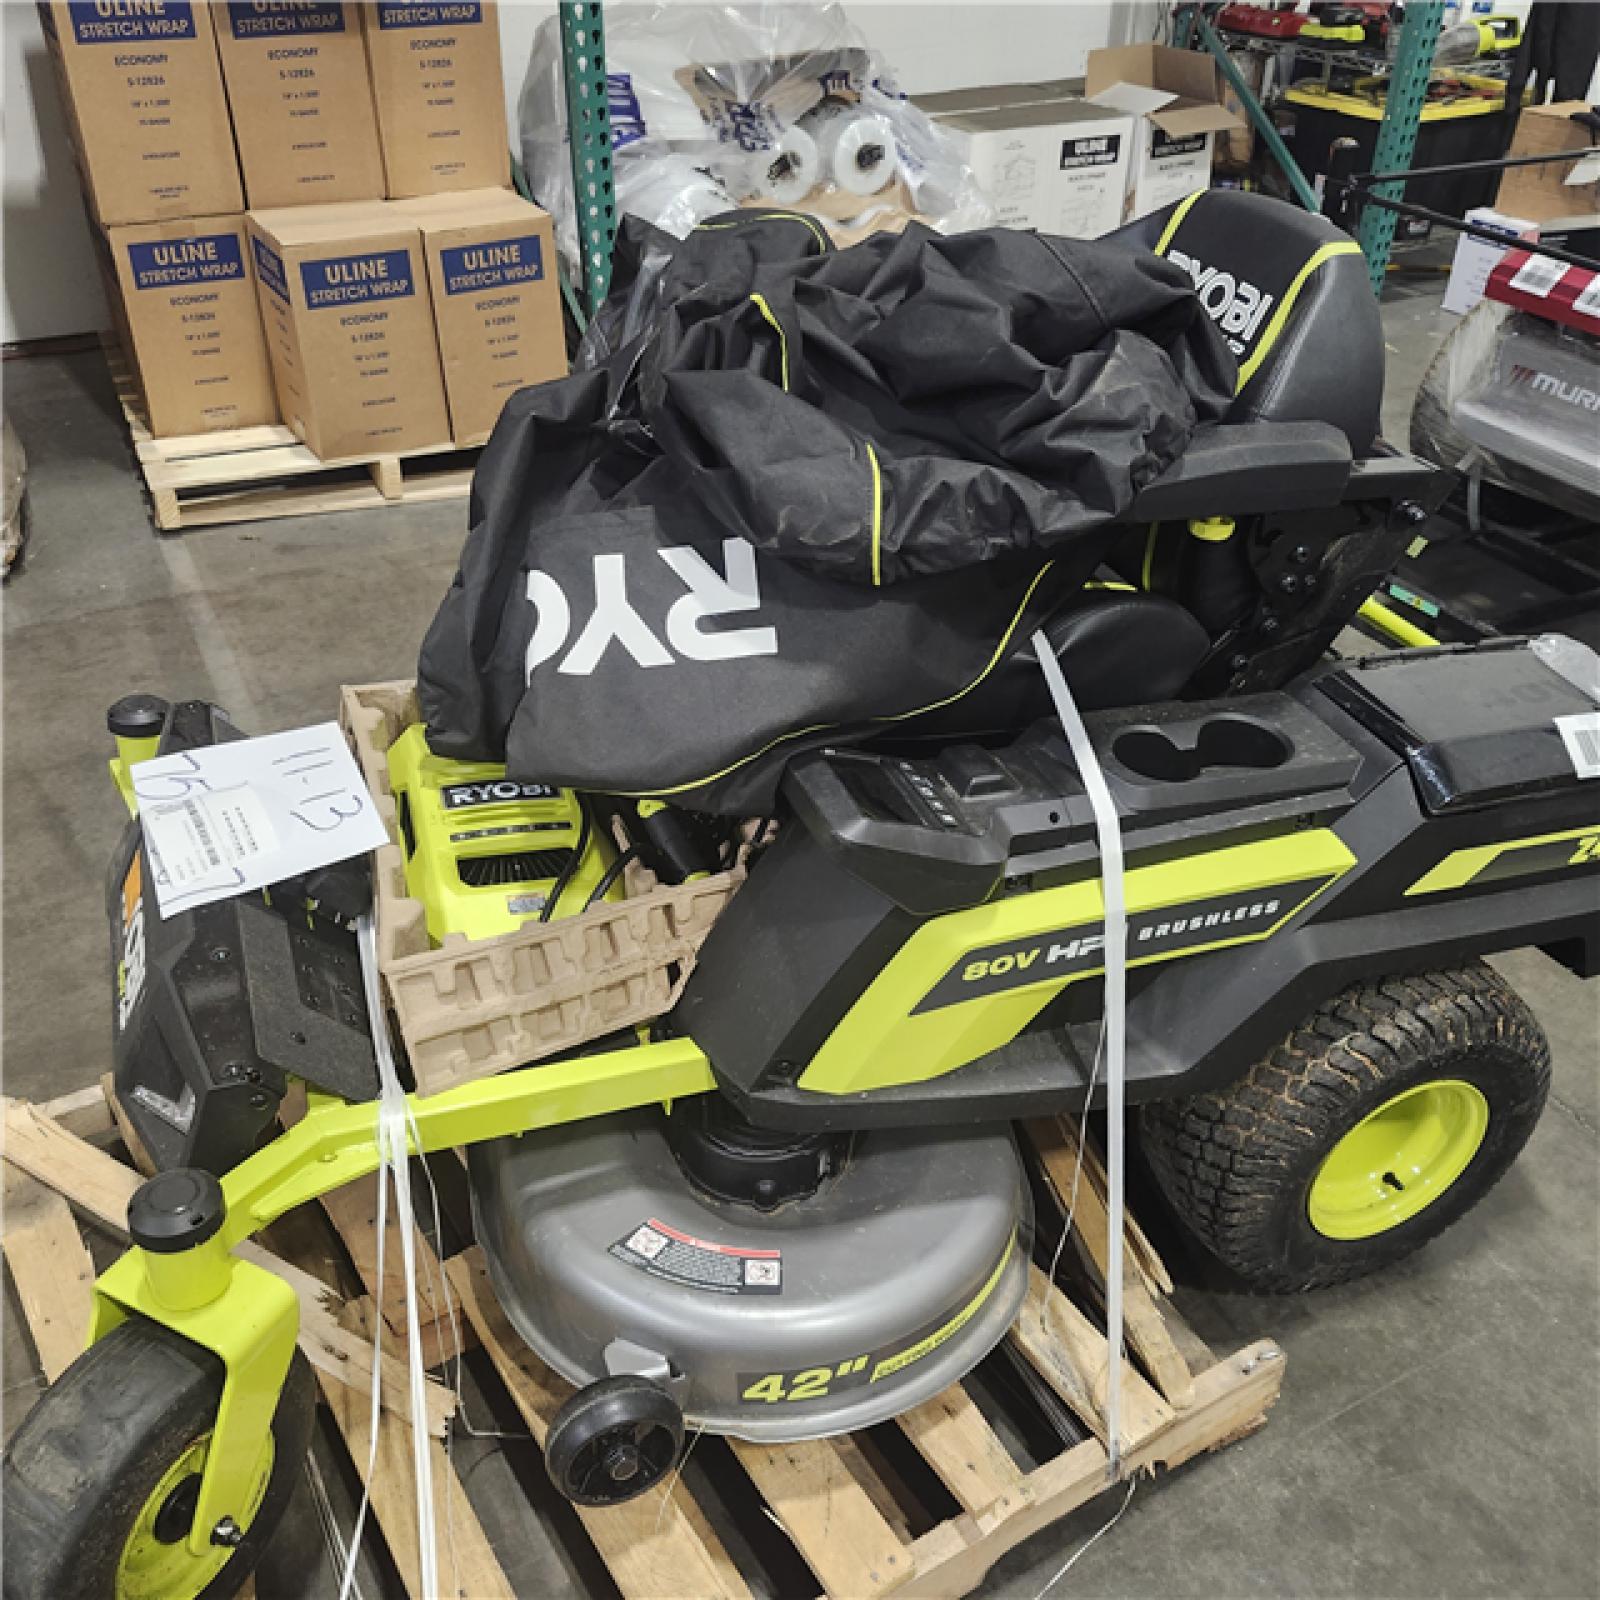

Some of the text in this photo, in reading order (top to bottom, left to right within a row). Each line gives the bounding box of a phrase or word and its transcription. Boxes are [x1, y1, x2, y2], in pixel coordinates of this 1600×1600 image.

[238, 14, 338, 33] STRETCH WRAP
[384, 5, 476, 24] STRETCH WRAP
[79, 19, 189, 39] STRETCH WRAP
[152, 241, 219, 266] ULINE
[463, 245, 521, 271] ULINE
[139, 262, 239, 286] STRETCH WRAP
[324, 259, 389, 285] ULINE
[450, 264, 539, 291] STRETCH WRAP
[310, 279, 409, 304] STRETCH WRAP
[449, 782, 551, 805] RYOBI
[961, 948, 1041, 982] 80V
[1137, 899, 1281, 942] BRUSHLESS
[742, 1354, 870, 1404] 42"
